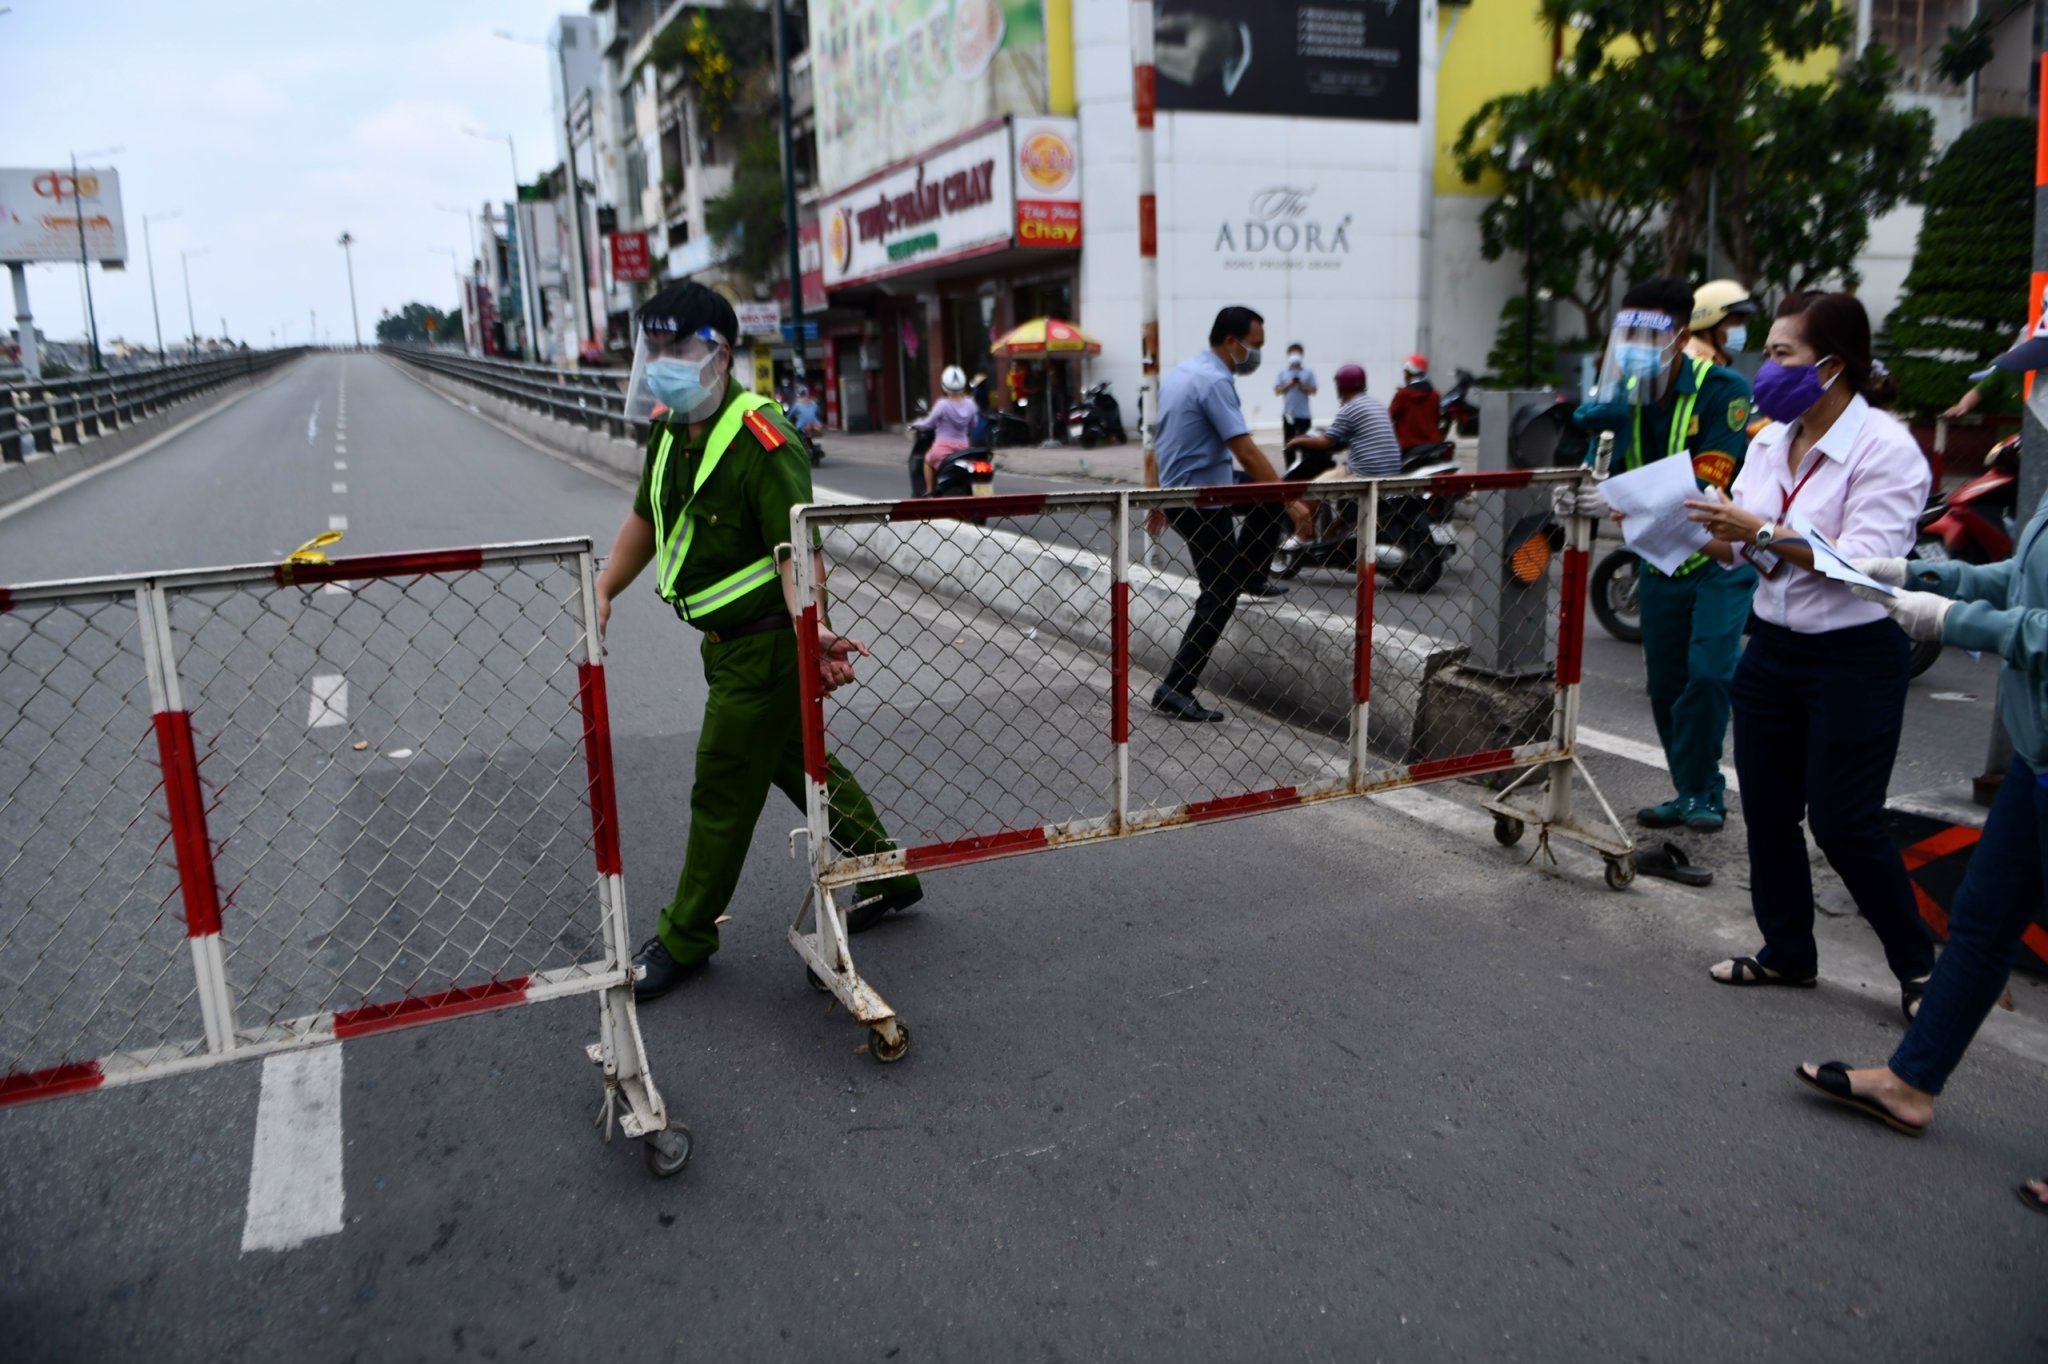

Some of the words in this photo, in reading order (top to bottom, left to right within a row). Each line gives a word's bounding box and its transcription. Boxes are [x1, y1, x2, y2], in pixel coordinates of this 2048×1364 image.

[943, 159, 994, 214] CHAY
[1249, 184, 1319, 221] The
[1020, 221, 1078, 243] Chay
[1214, 221, 1350, 253] ADORA
